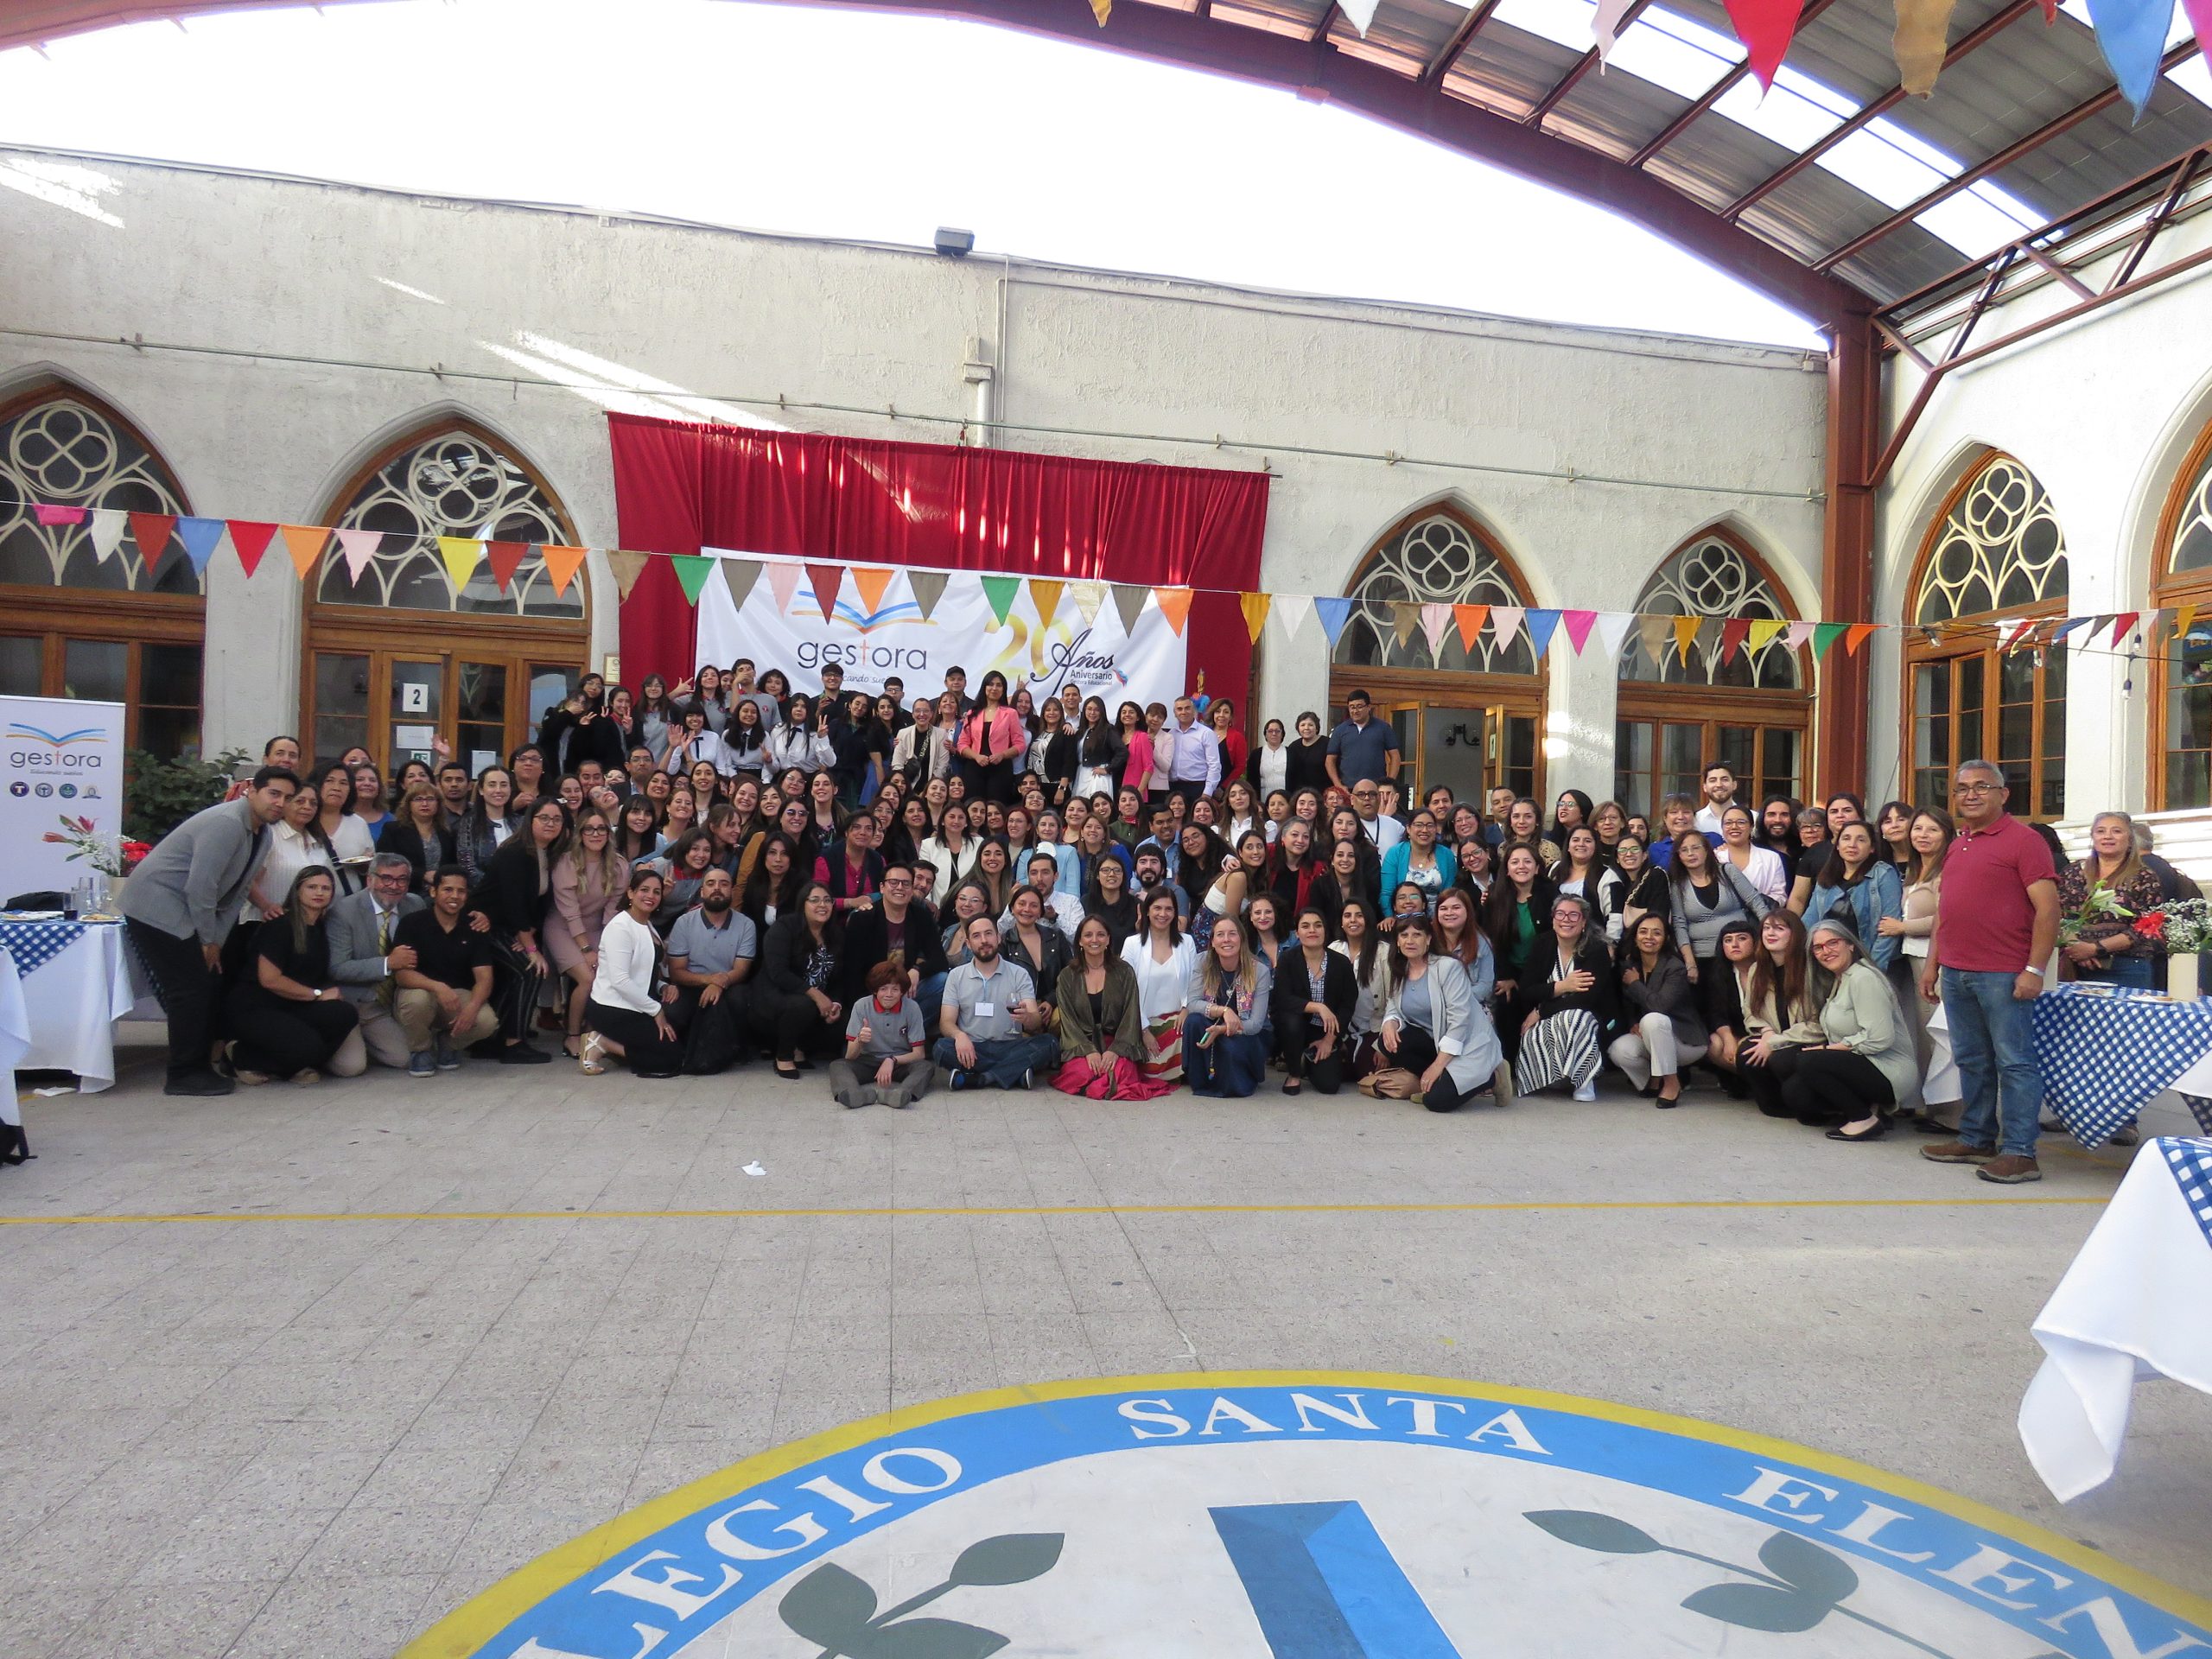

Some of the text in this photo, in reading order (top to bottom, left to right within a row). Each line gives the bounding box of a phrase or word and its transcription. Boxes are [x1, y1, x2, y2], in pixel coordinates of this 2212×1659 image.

[798, 639, 927, 670] gestora
[982, 613, 1115, 696] 20 Años
[1070, 670, 1113, 680] Aniversario
[413, 689, 421, 704] 2
[10, 751, 101, 768] gestora
[1117, 1393, 1554, 1456] SANTA
